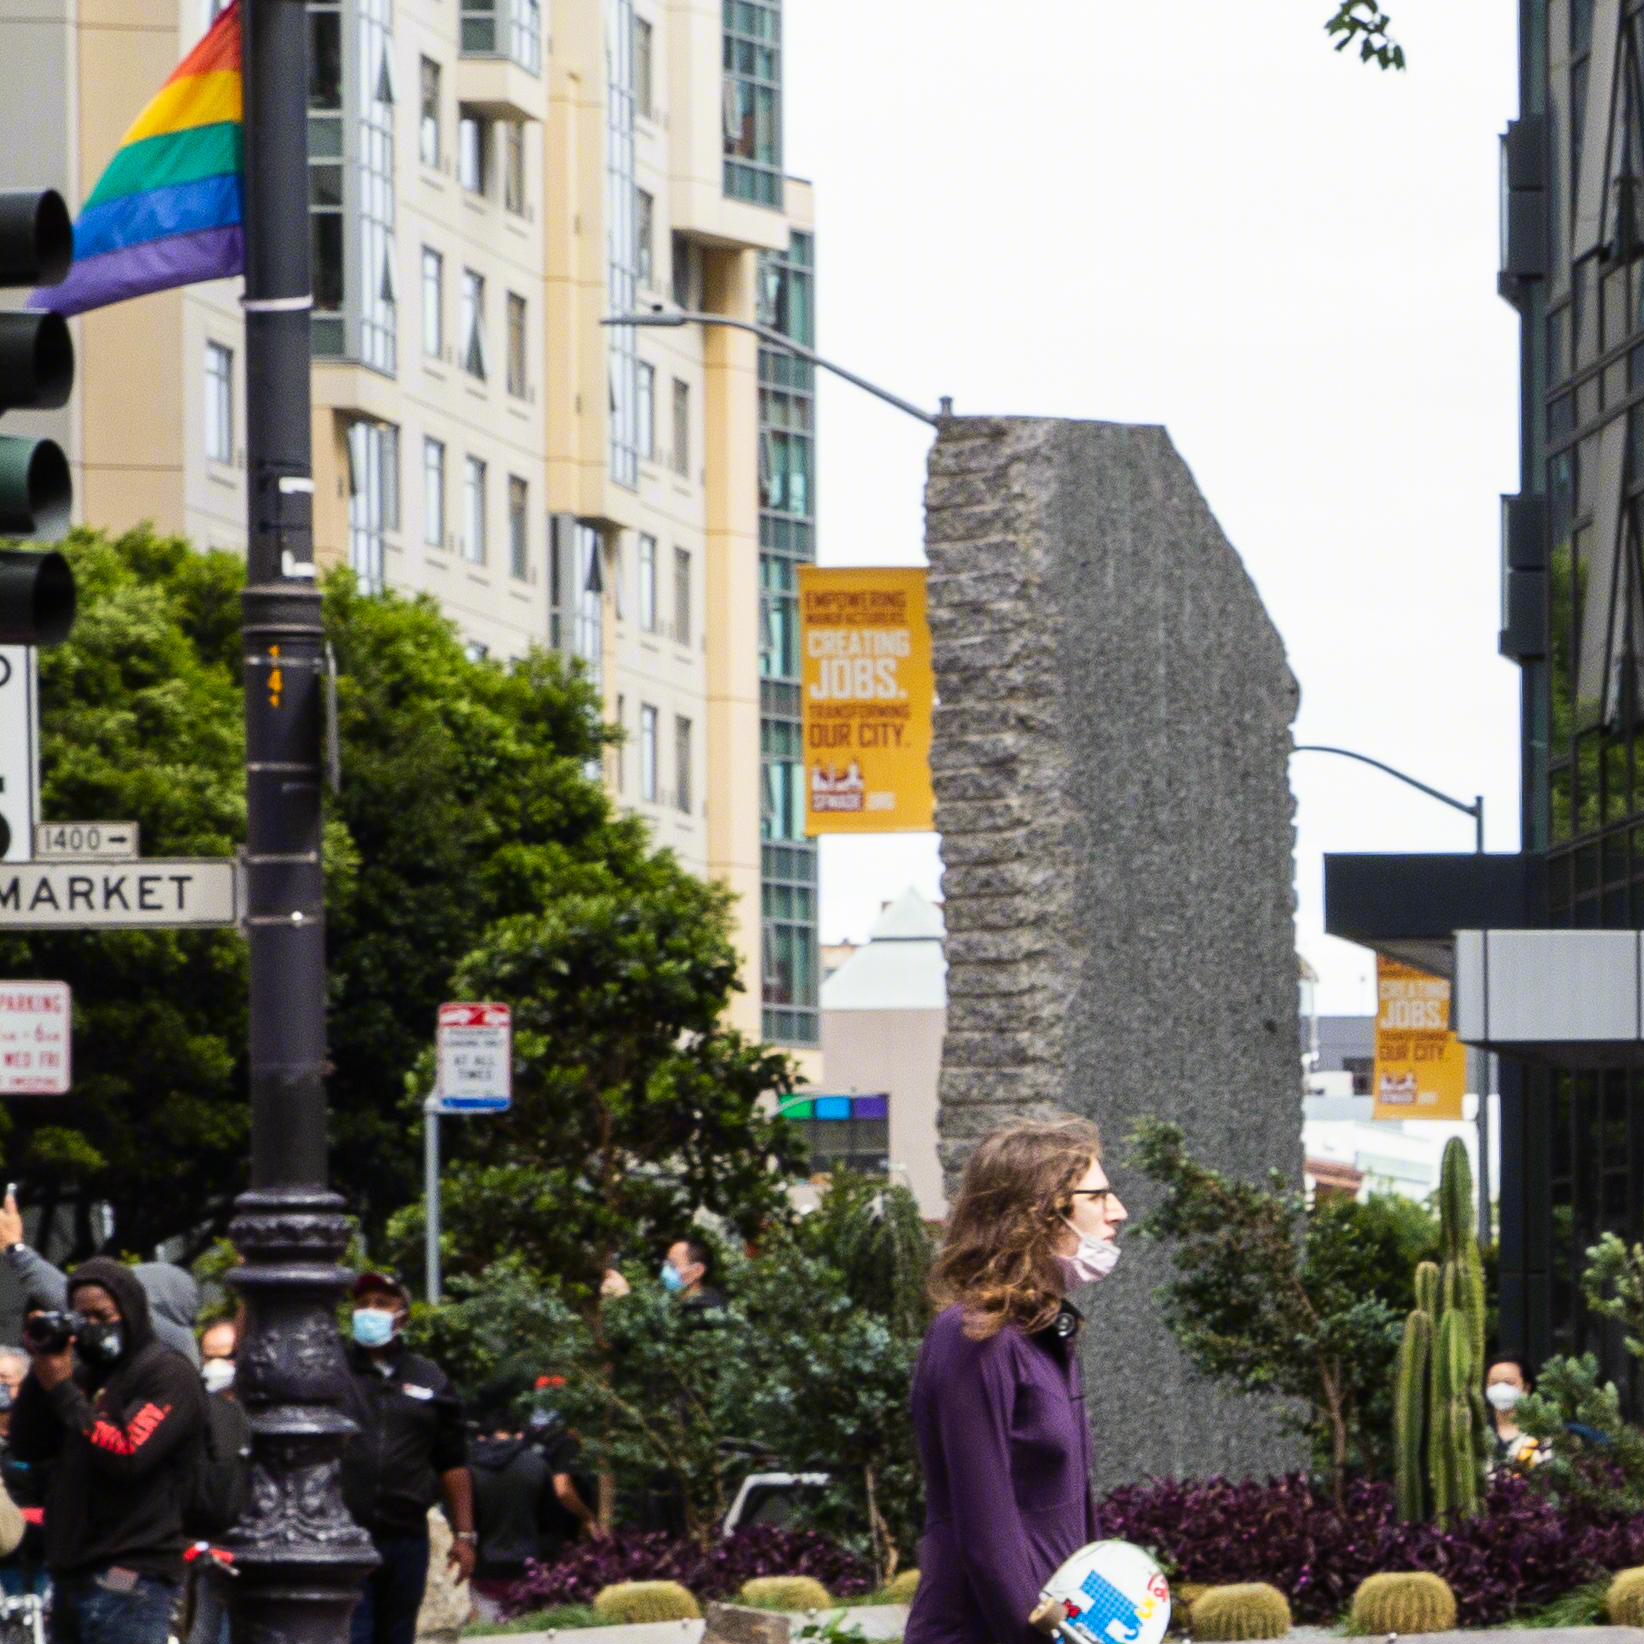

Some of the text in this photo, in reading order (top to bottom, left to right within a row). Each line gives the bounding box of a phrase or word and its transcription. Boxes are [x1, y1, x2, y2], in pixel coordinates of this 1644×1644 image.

[808, 629, 911, 657] CREATING
[810, 659, 908, 699] JOBS.
[809, 723, 851, 748] OUR
[45, 829, 100, 849] 1400
[1380, 1000, 1449, 1028] JOBS.
